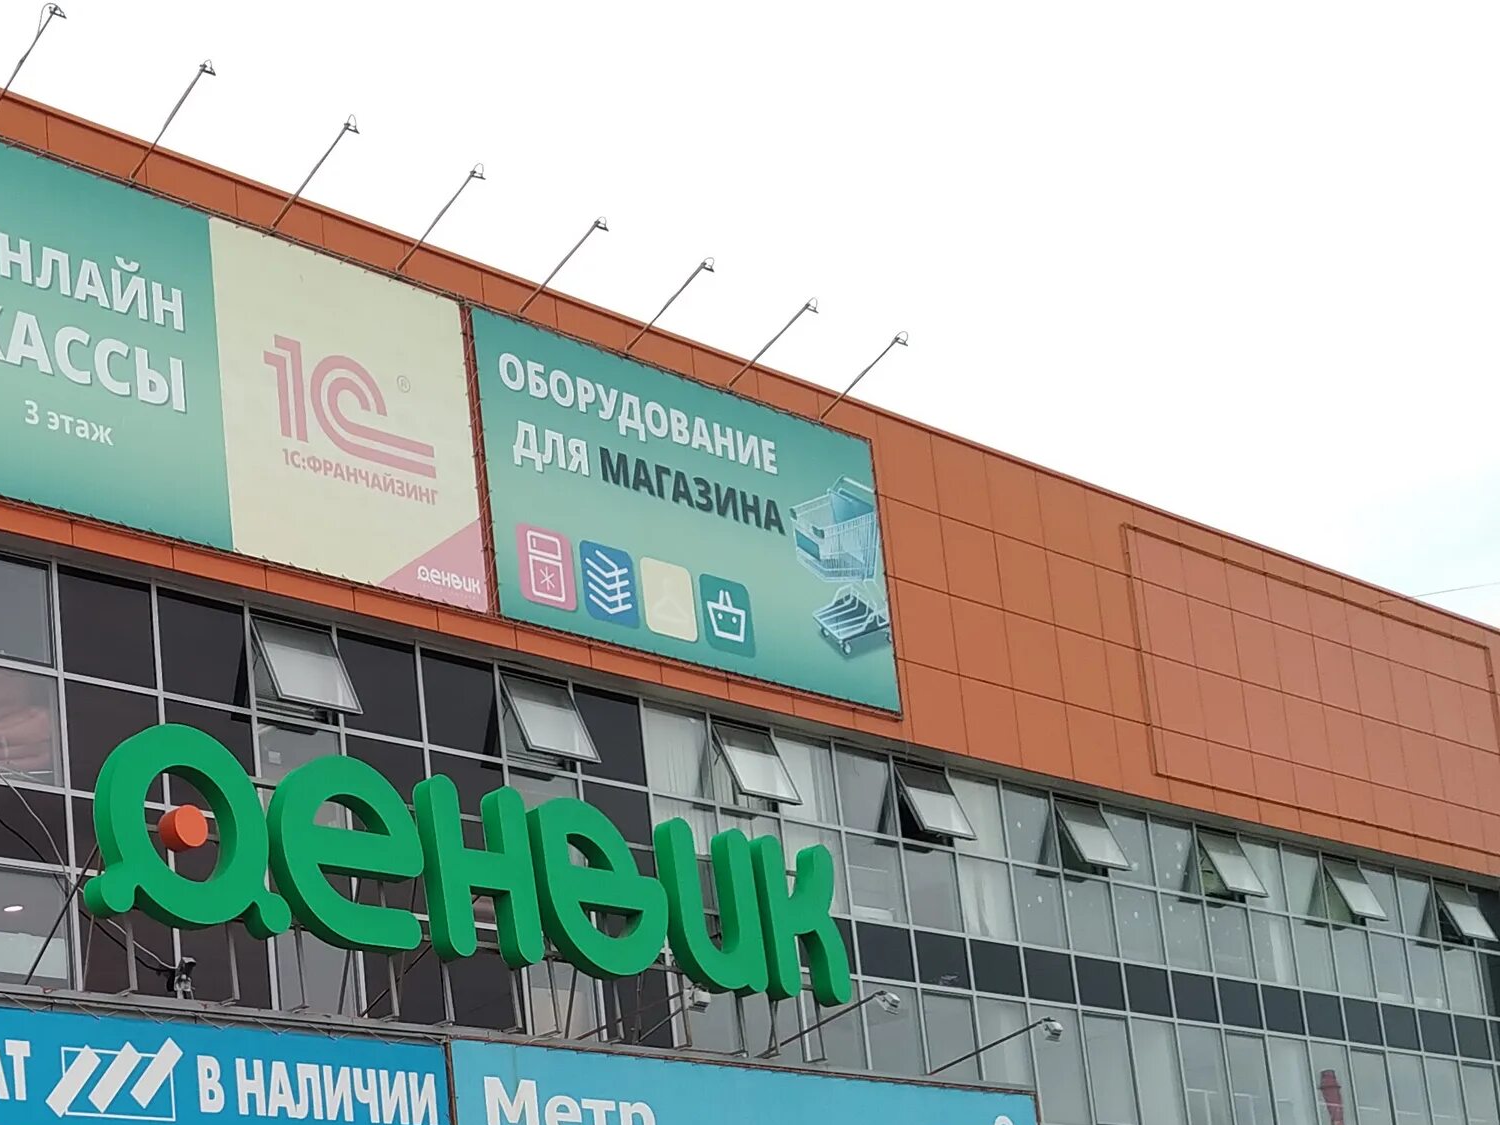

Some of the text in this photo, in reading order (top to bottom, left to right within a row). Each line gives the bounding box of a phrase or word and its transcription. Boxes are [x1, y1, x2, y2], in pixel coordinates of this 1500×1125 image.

[24, 400, 114, 446] 3 этаж
[499, 352, 779, 475] ОБОРУДОВАНИЕ
[282, 447, 438, 506] 1С:ФРАНЧАЙЗИНГ
[513, 420, 786, 536] ДЛЯ МАГАЗИНА
[199, 1055, 225, 1114] В
